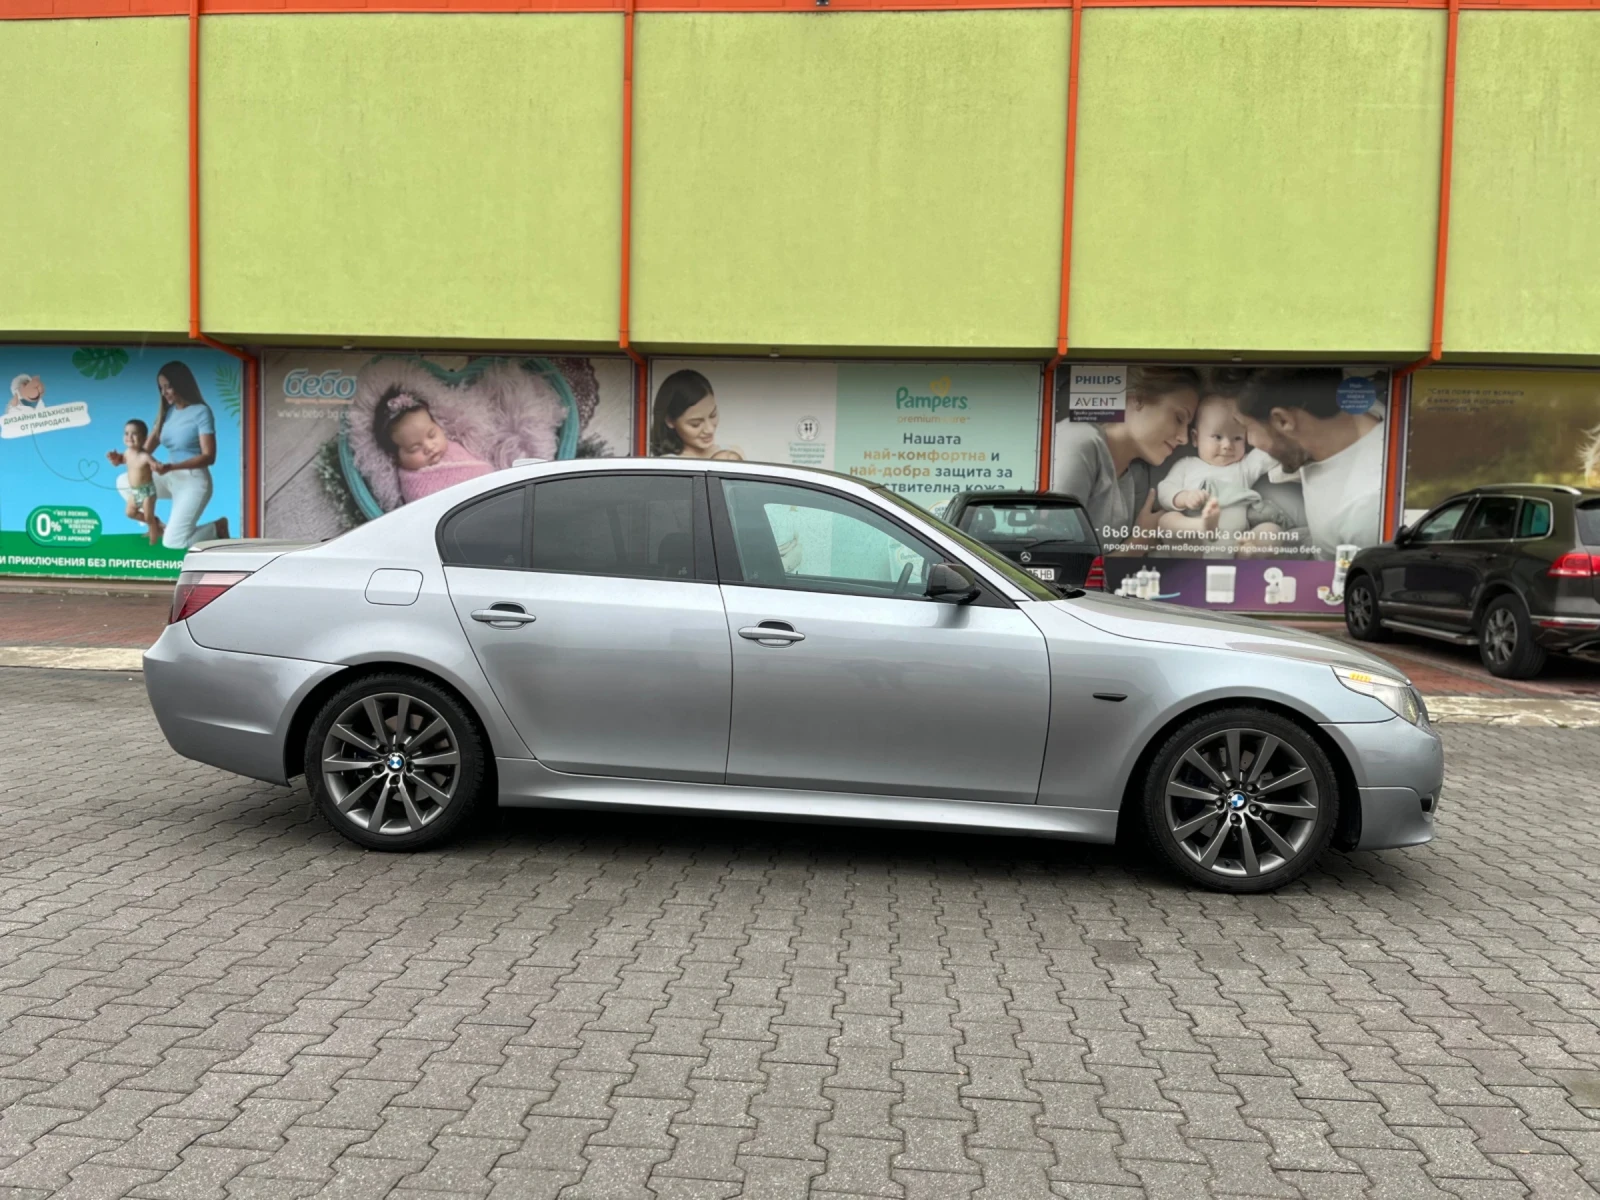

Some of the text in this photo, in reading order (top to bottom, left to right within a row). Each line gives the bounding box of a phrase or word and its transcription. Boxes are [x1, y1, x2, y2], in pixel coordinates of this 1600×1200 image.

[282, 368, 357, 398] бебо
[1075, 375, 1122, 385] PHILIPS
[895, 386, 969, 412] Pampers
[1074, 397, 1118, 407] AVENT
[3, 405, 85, 425] ДИЗАЙНИ ВДЪХНОВЕНИ
[897, 415, 940, 425] premium
[20, 416, 71, 431] ОТ ПРИРОДАТА
[903, 432, 962, 445] Нашата
[863, 448, 1000, 464] най-комфортна и
[849, 464, 1013, 480] най-добра защита за
[36, 513, 62, 537] 0%
[1102, 525, 1299, 541] във всяка стъпка от пътя
[1103, 542, 1149, 552] продукти
[1171, 543, 1226, 553] новородено
[1227, 545, 1239, 554] до
[1299, 545, 1322, 554] бебе
[8, 555, 86, 567] ПРИКЛЮЧЕНИЯ
[88, 558, 107, 568] БЕЗ
[109, 558, 184, 570] ПРИТЕСНЕНИЯ
